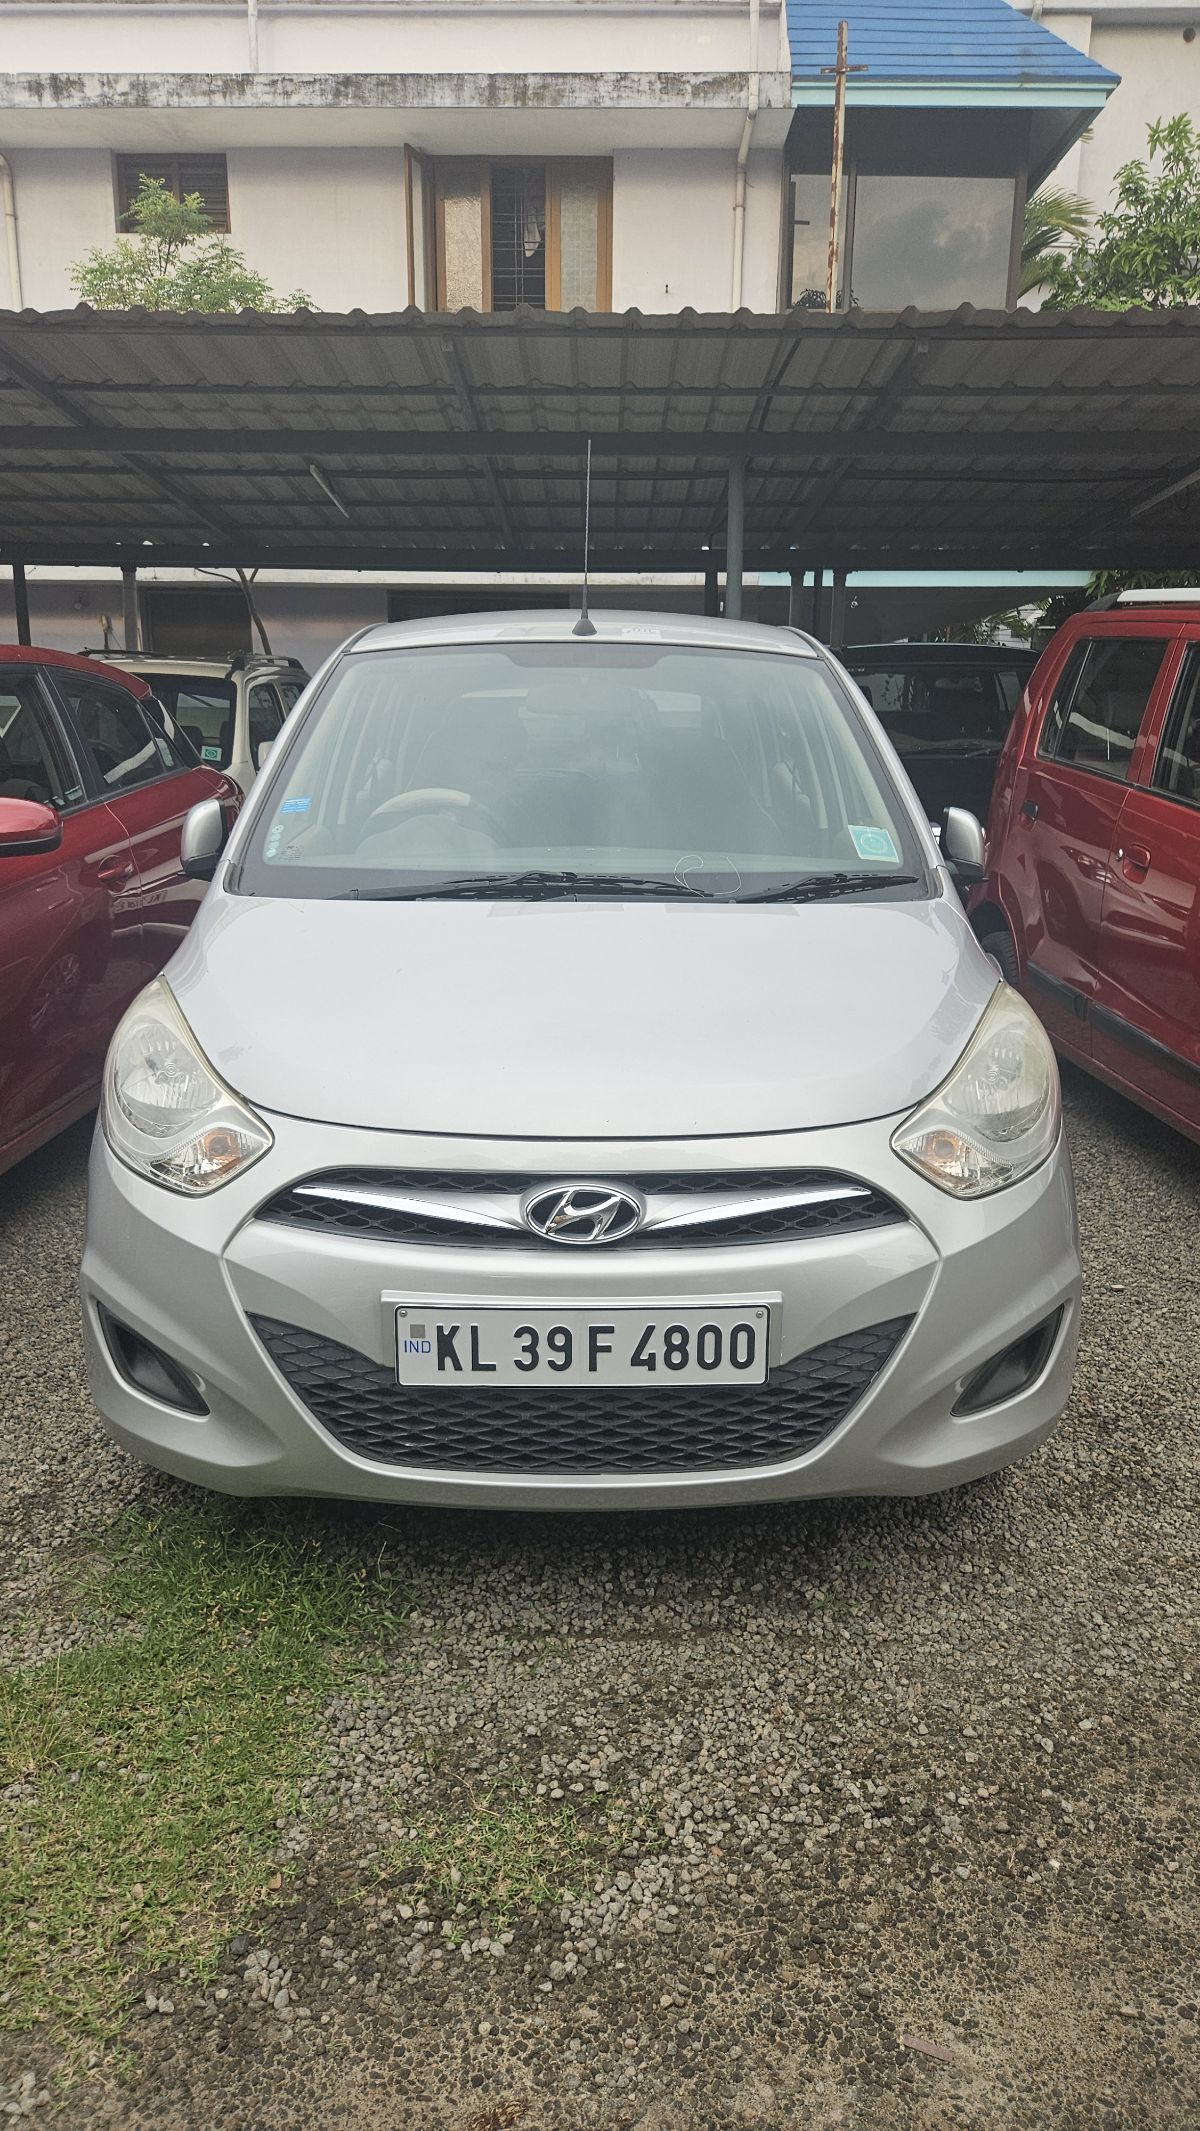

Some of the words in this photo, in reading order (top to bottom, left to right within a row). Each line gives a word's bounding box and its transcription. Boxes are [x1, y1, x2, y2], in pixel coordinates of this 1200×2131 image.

[404, 1339, 431, 1353] IND
[437, 1325, 497, 1372] KL
[513, 1325, 573, 1372] 39
[588, 1325, 615, 1372] F
[630, 1323, 756, 1371] 4800
